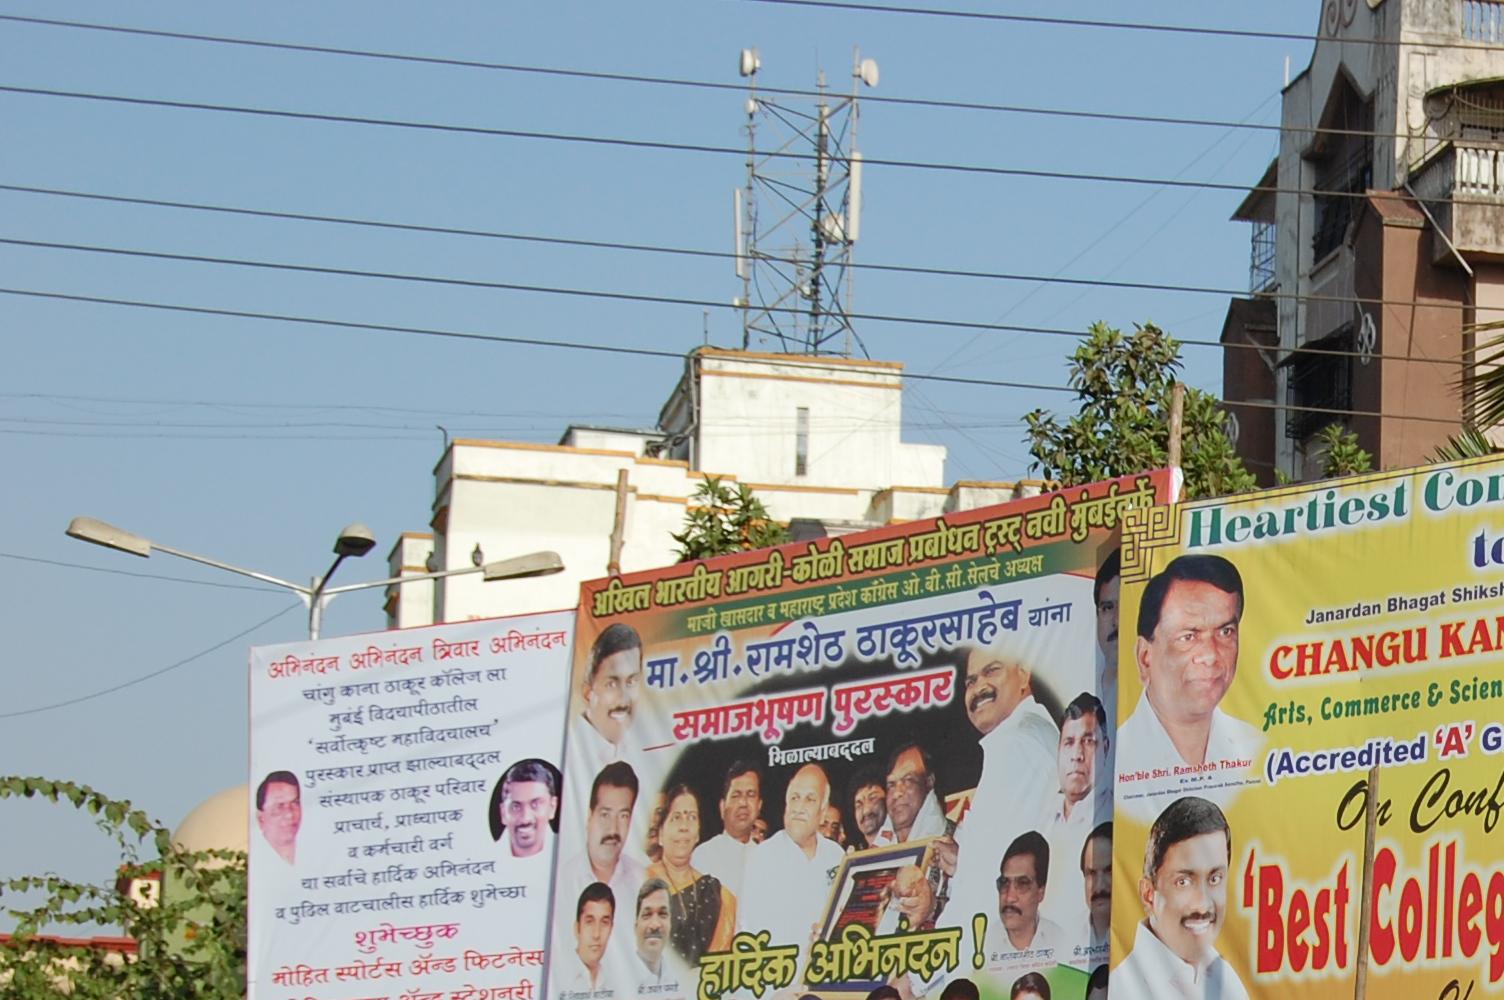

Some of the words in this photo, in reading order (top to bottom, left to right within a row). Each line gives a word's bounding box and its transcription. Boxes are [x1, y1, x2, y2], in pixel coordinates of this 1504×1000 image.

[1188, 479, 1409, 548] Heartiest
[594, 579, 652, 617] अखिल
[656, 565, 722, 605] भारतीय
[849, 536, 905, 574] समाज
[908, 520, 981, 562] प्रबोधन
[1026, 494, 1067, 538] नवी
[1028, 599, 1072, 627] यांना
[1306, 603, 1381, 625] Janardan
[1387, 589, 1445, 613] Bhagat
[1269, 624, 1428, 680] CHANGU
[673, 687, 826, 741] समाजभूषण
[834, 670, 955, 731] पुरस्कार
[1263, 701, 1312, 731] Arts,
[1321, 690, 1420, 720] Commerce
[1427, 683, 1442, 707] &
[1266, 735, 1425, 782] (Accredited
[1337, 780, 1392, 831] On
[805, 919, 962, 984] अभिनंदन
